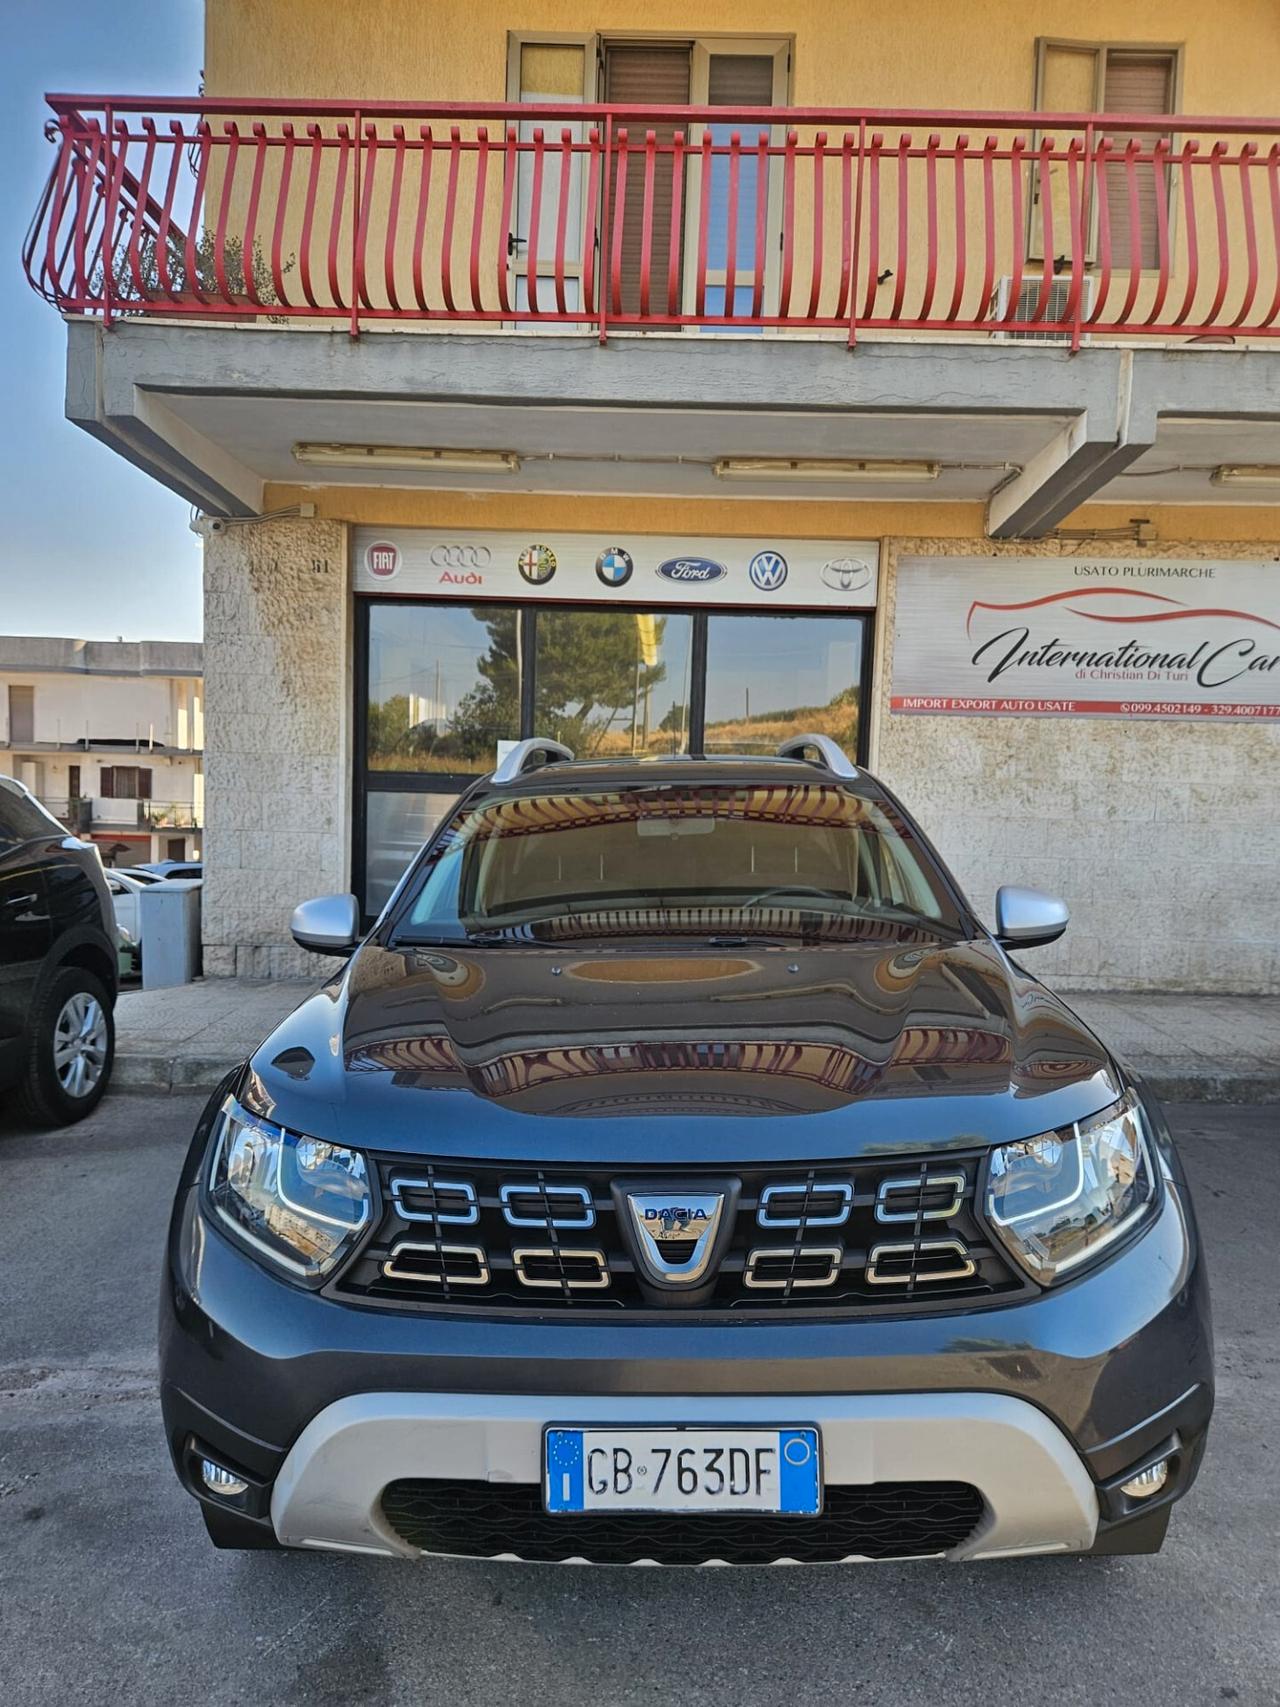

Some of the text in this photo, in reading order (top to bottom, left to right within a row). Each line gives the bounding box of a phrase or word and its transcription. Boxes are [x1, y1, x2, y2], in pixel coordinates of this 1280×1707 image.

[373, 552, 394, 570] FIAT
[670, 560, 710, 580] Ford
[1074, 566, 1216, 579] USATO PLURIMARCHE
[438, 571, 483, 585] Audi
[971, 627, 1210, 683] International
[1075, 669, 1189, 681] di Christian Di Turi
[903, 698, 1076, 712] IMPORT EXPORT AUTO USATE
[645, 1208, 707, 1220] DACIA
[588, 1447, 776, 1496] GB 763DF
